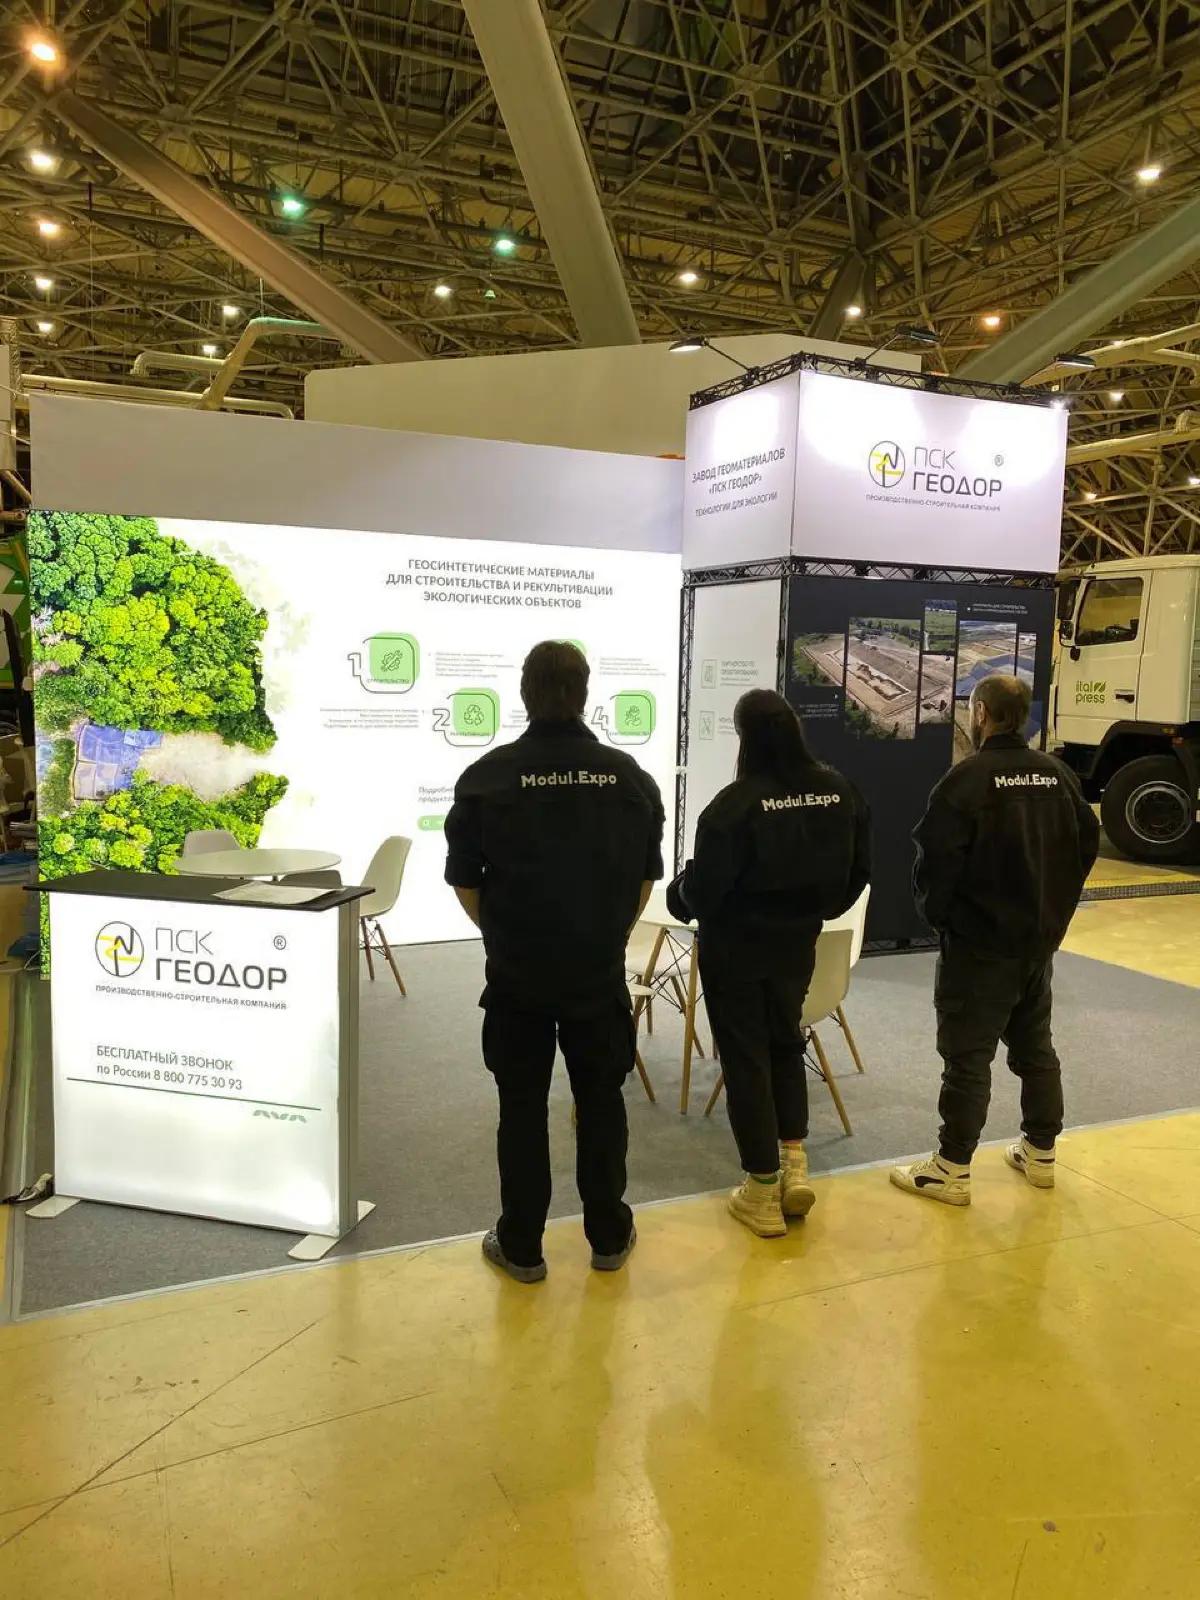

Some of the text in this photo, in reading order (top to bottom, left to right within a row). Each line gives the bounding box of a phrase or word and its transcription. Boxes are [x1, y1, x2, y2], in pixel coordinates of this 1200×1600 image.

[692, 447, 786, 483] ЗАВОД ГЕОМАТЕРИАЛОВ
[914, 446, 955, 471] ПСК
[912, 471, 1002, 498] ГЕОДОР
[695, 491, 778, 517] ТЕХНОЛОГИИ ДЛЯ ЭКОЛОГИИ
[408, 558, 595, 580] ГЕОСИНТЕТИЧЕСКИЕ МАТЕРИАЛЫ
[386, 573, 613, 597] ДЛЯ СТРОИТЕЛЬСТВА И РЕКУЛЬТИВАЦИИ
[423, 591, 582, 609] ЭКОЛОГИЧЕСКИХ ОБЪЕКТОВ
[1075, 692, 1105, 705] press
[520, 770, 617, 788] Modul.Expo
[995, 774, 1058, 788] Modul.Expo
[761, 792, 840, 811] Modul.Expo
[155, 927, 214, 955] ПСК
[155, 958, 288, 991] ГЕОДОР
[95, 984, 287, 1010] ПРОИЗВОДСТВЕННО-СТРОИТЕЛЬНАЯ КОМПАНИЯ
[96, 1045, 233, 1071] БЕСПЛАТНЫЙ ЗВОНОК
[96, 1064, 243, 1090] по России 8 800 775 30 93
